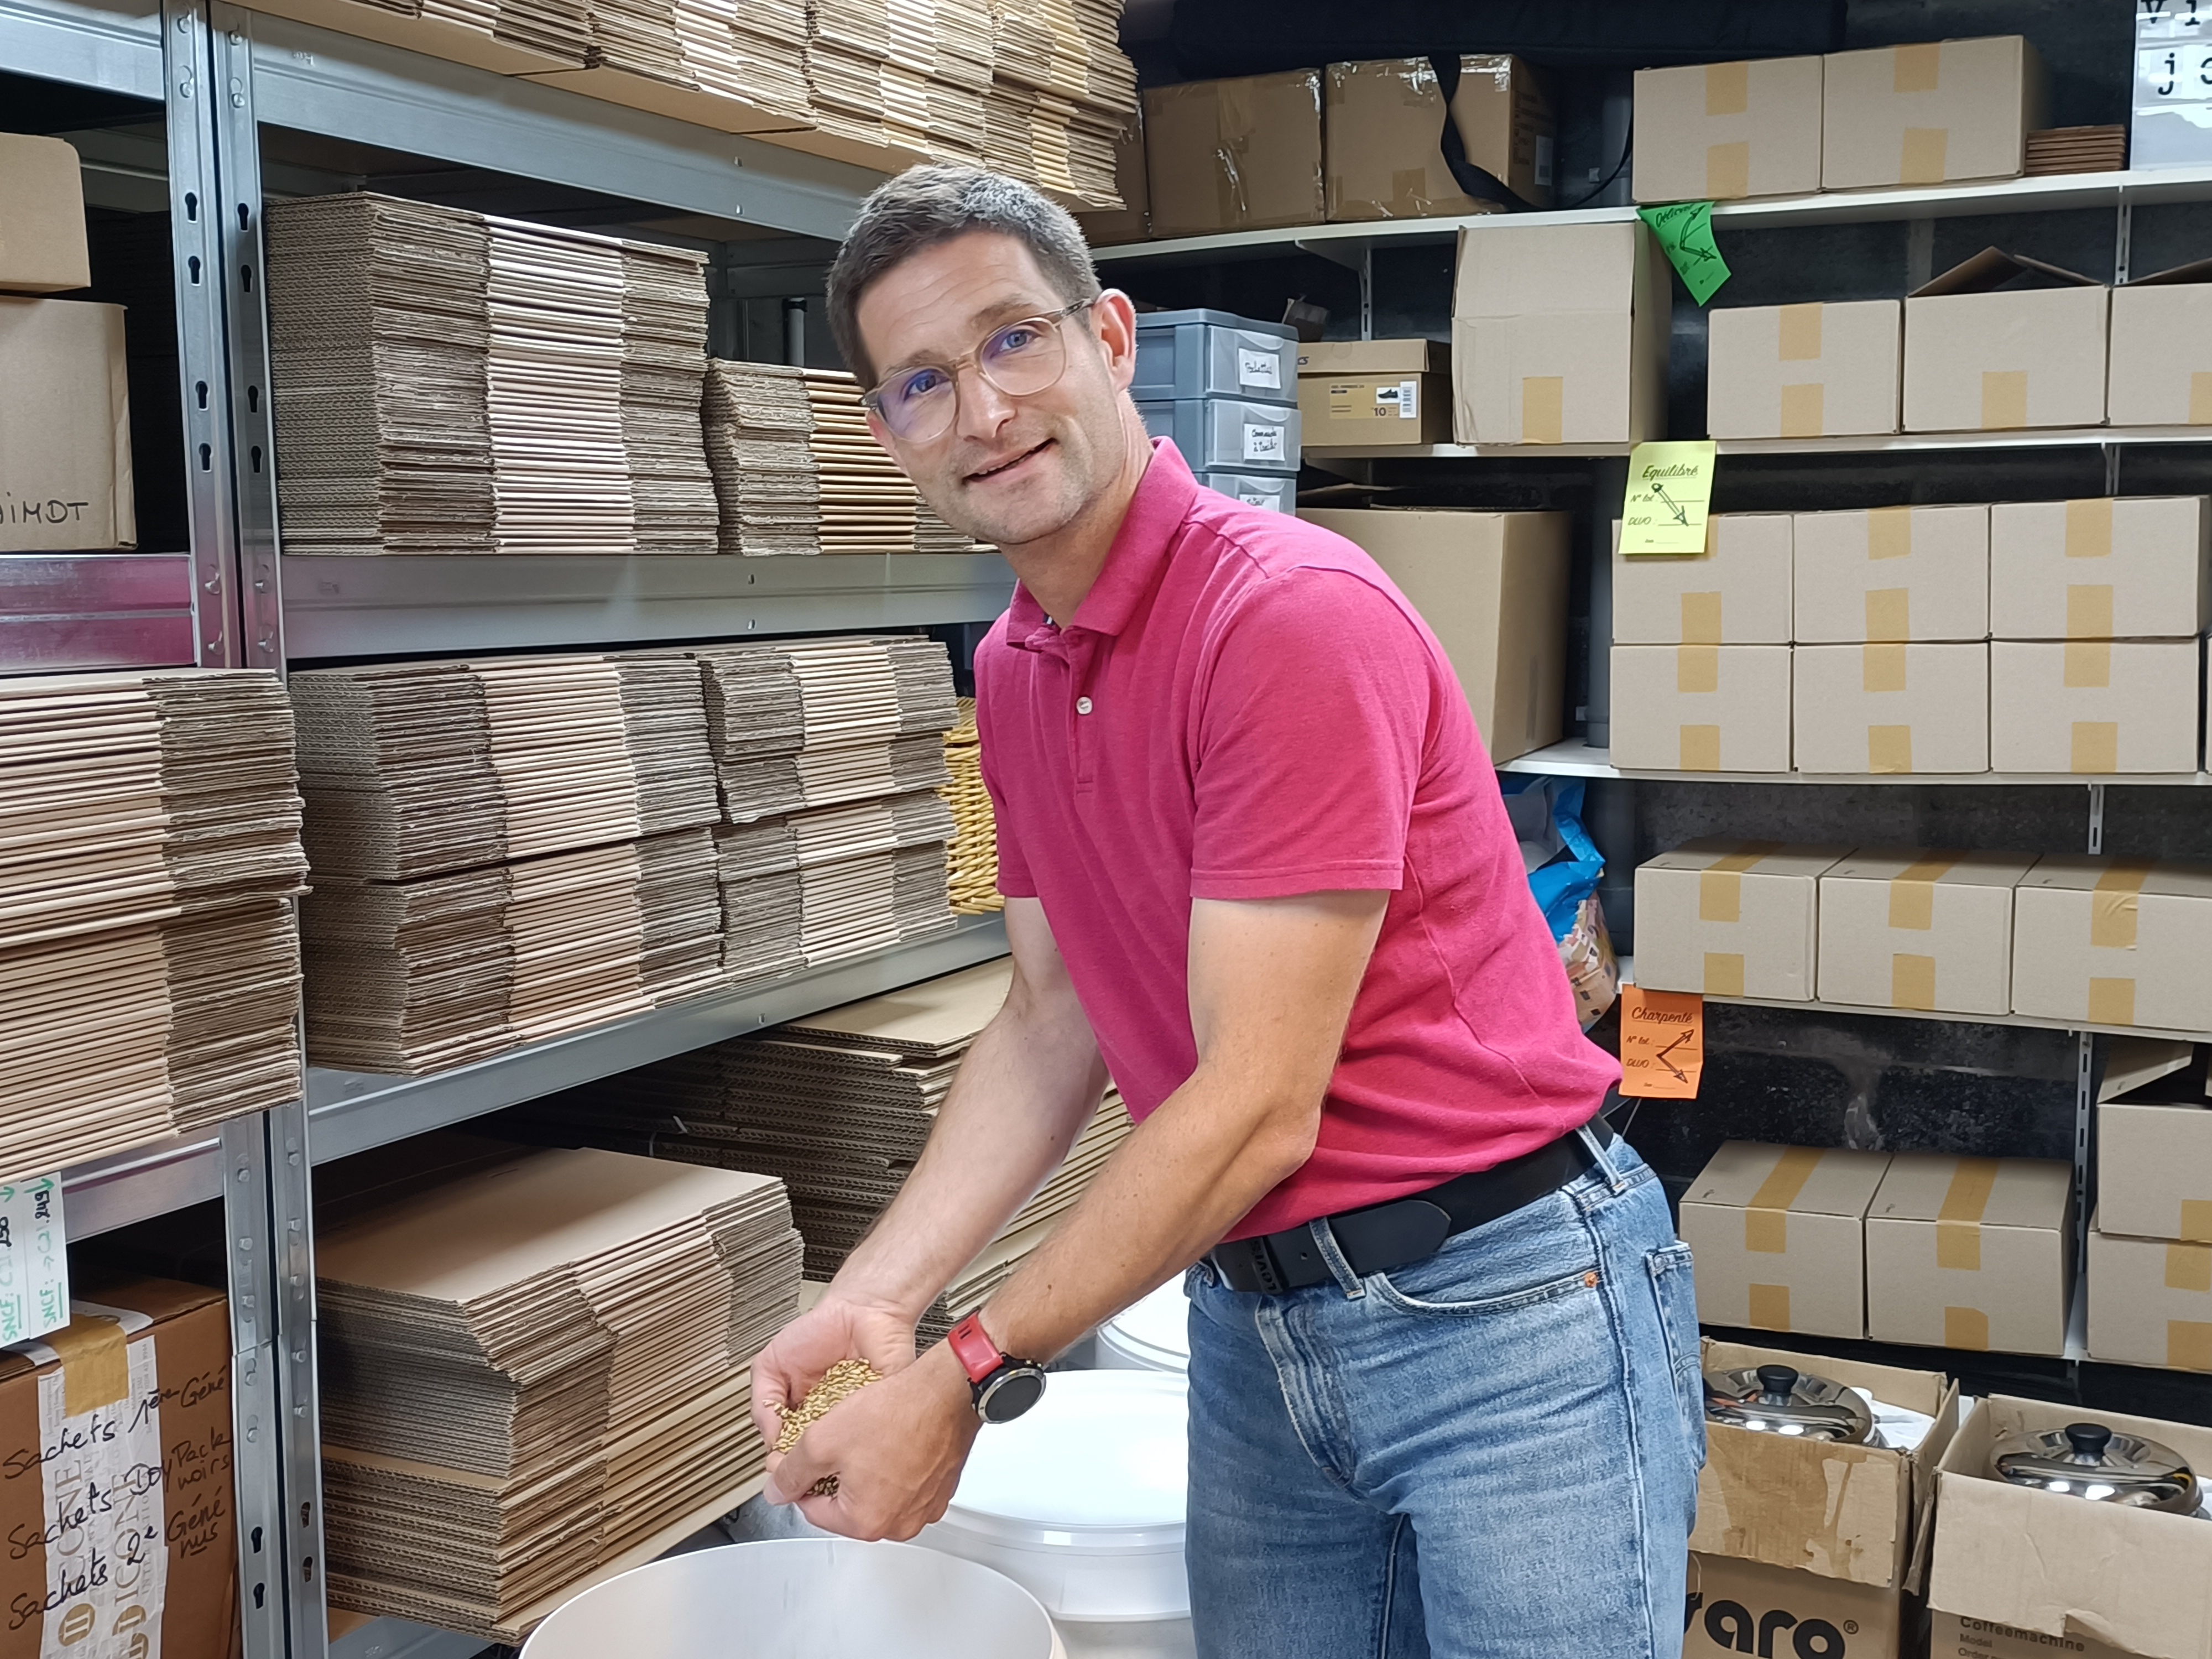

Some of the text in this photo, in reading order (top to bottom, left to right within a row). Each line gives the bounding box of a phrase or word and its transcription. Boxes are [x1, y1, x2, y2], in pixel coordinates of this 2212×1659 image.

[1374, 407, 1386, 416] 10
[1959, 1616, 2085, 1652] Coffeemachine
[1959, 1634, 1993, 1648] Model
